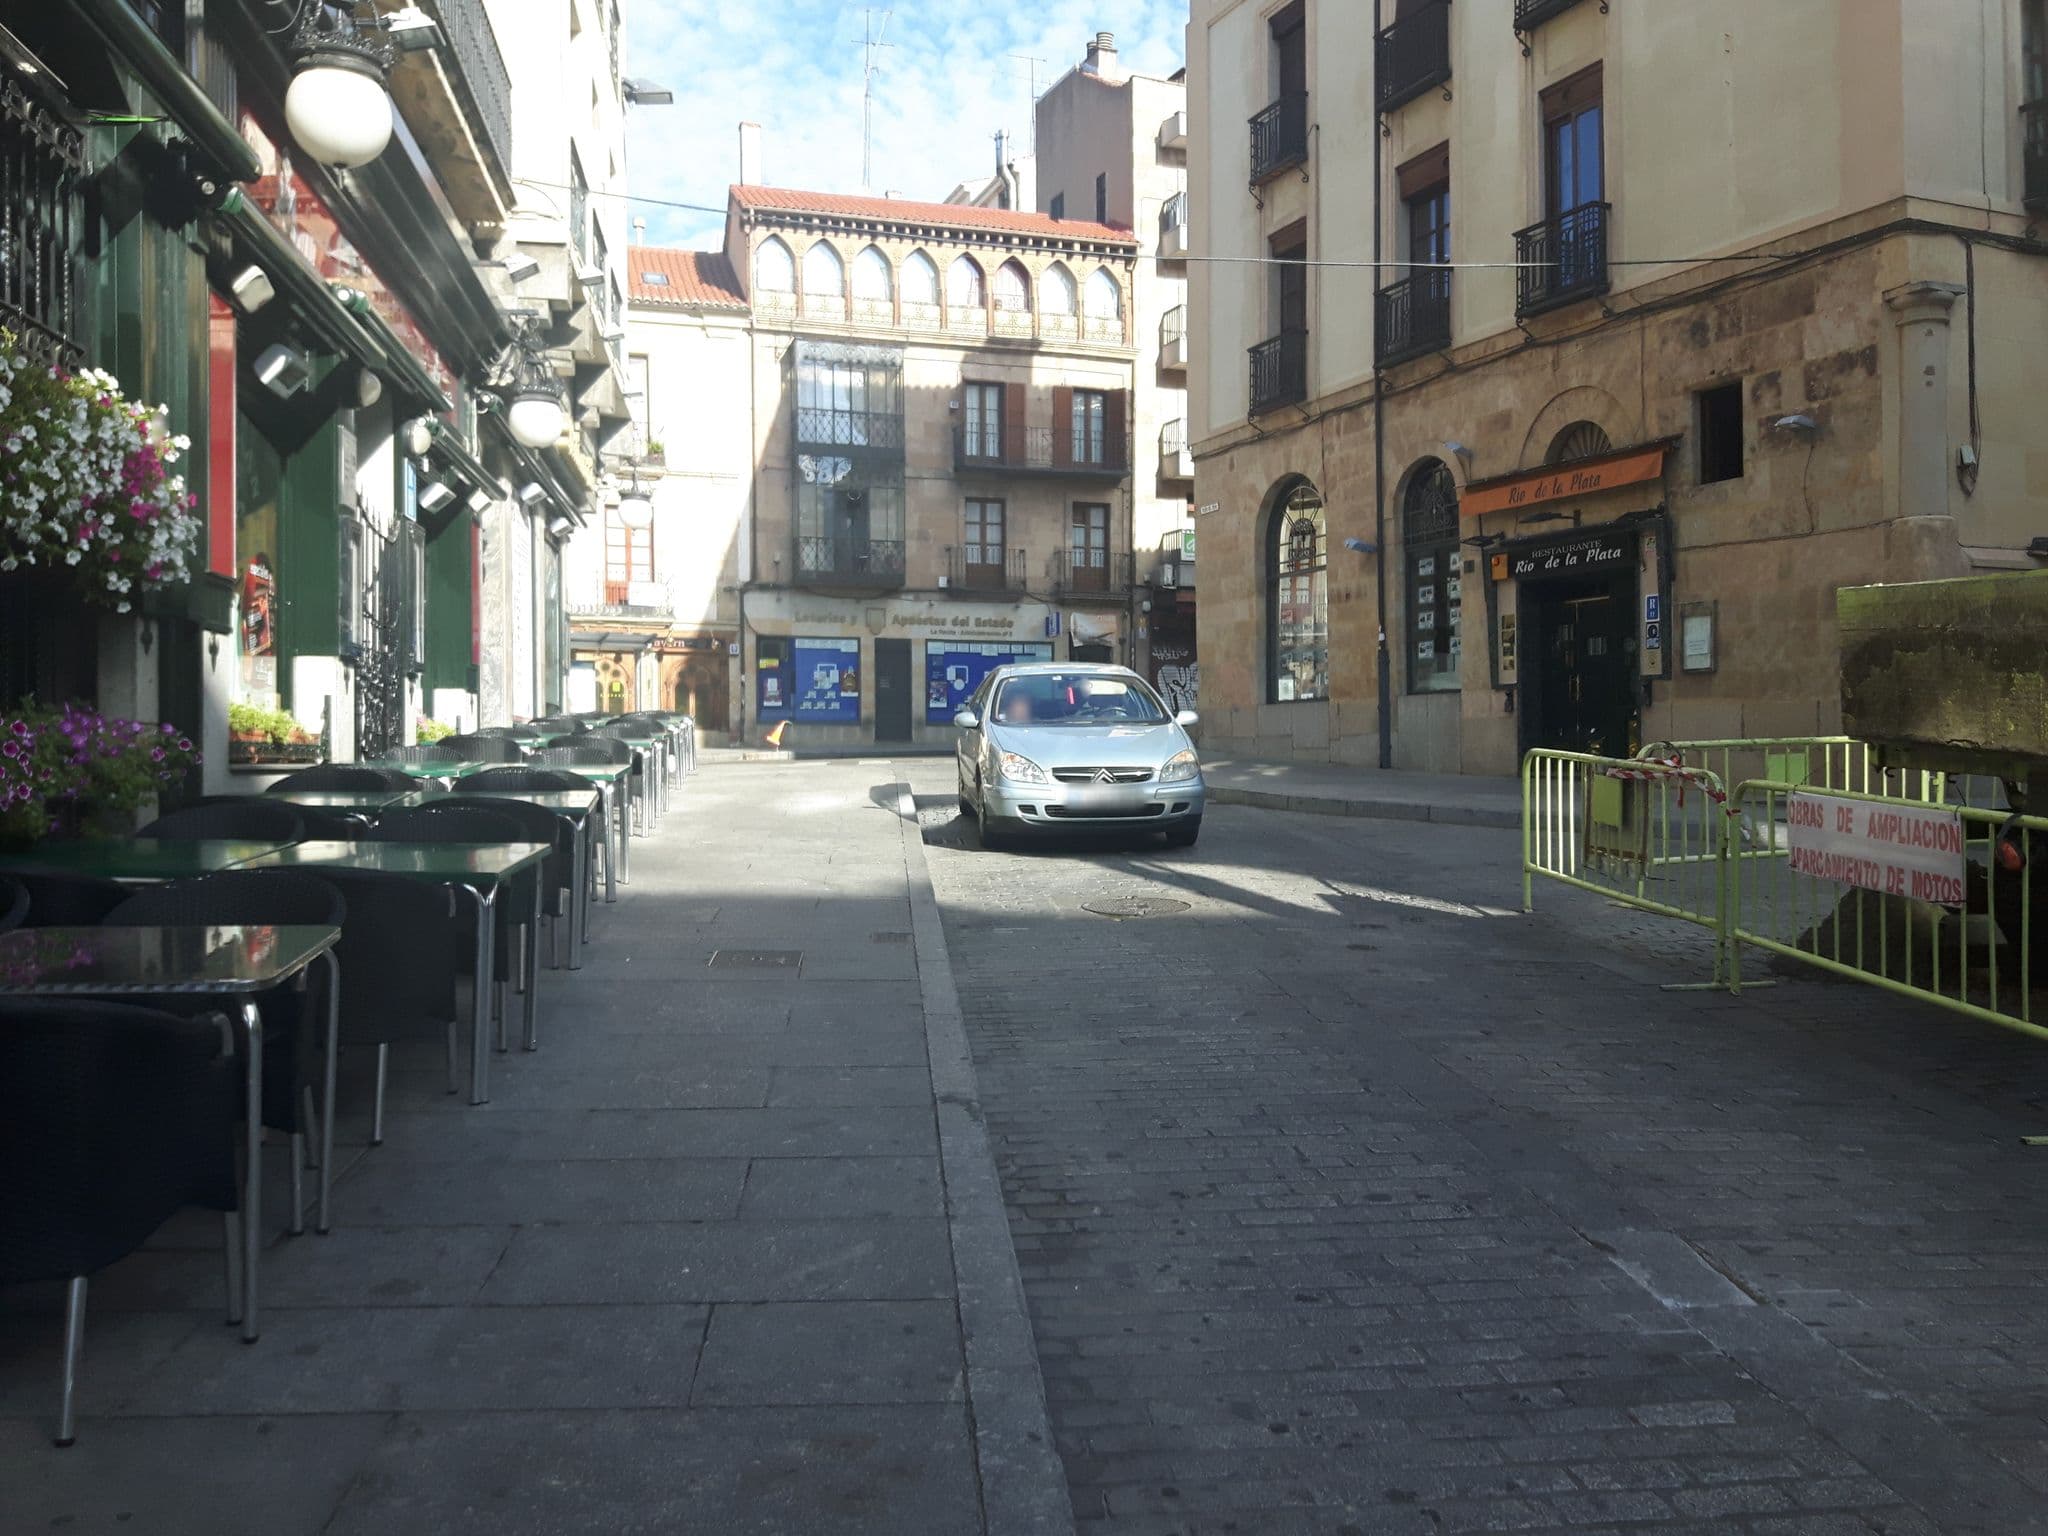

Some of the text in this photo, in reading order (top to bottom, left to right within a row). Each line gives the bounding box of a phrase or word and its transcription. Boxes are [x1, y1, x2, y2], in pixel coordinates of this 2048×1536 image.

[1508, 472, 1601, 505] Rio de la Plata
[1515, 547, 1622, 574] Rio de la Plata
[1531, 540, 1602, 558] RESTAURANTE
[952, 615, 970, 627] del
[974, 616, 1014, 629] Estado
[1788, 800, 1961, 853] OBRAS DE AMPLIACION
[1791, 845, 1962, 907] APARCAMIENTO DE MOTOS
